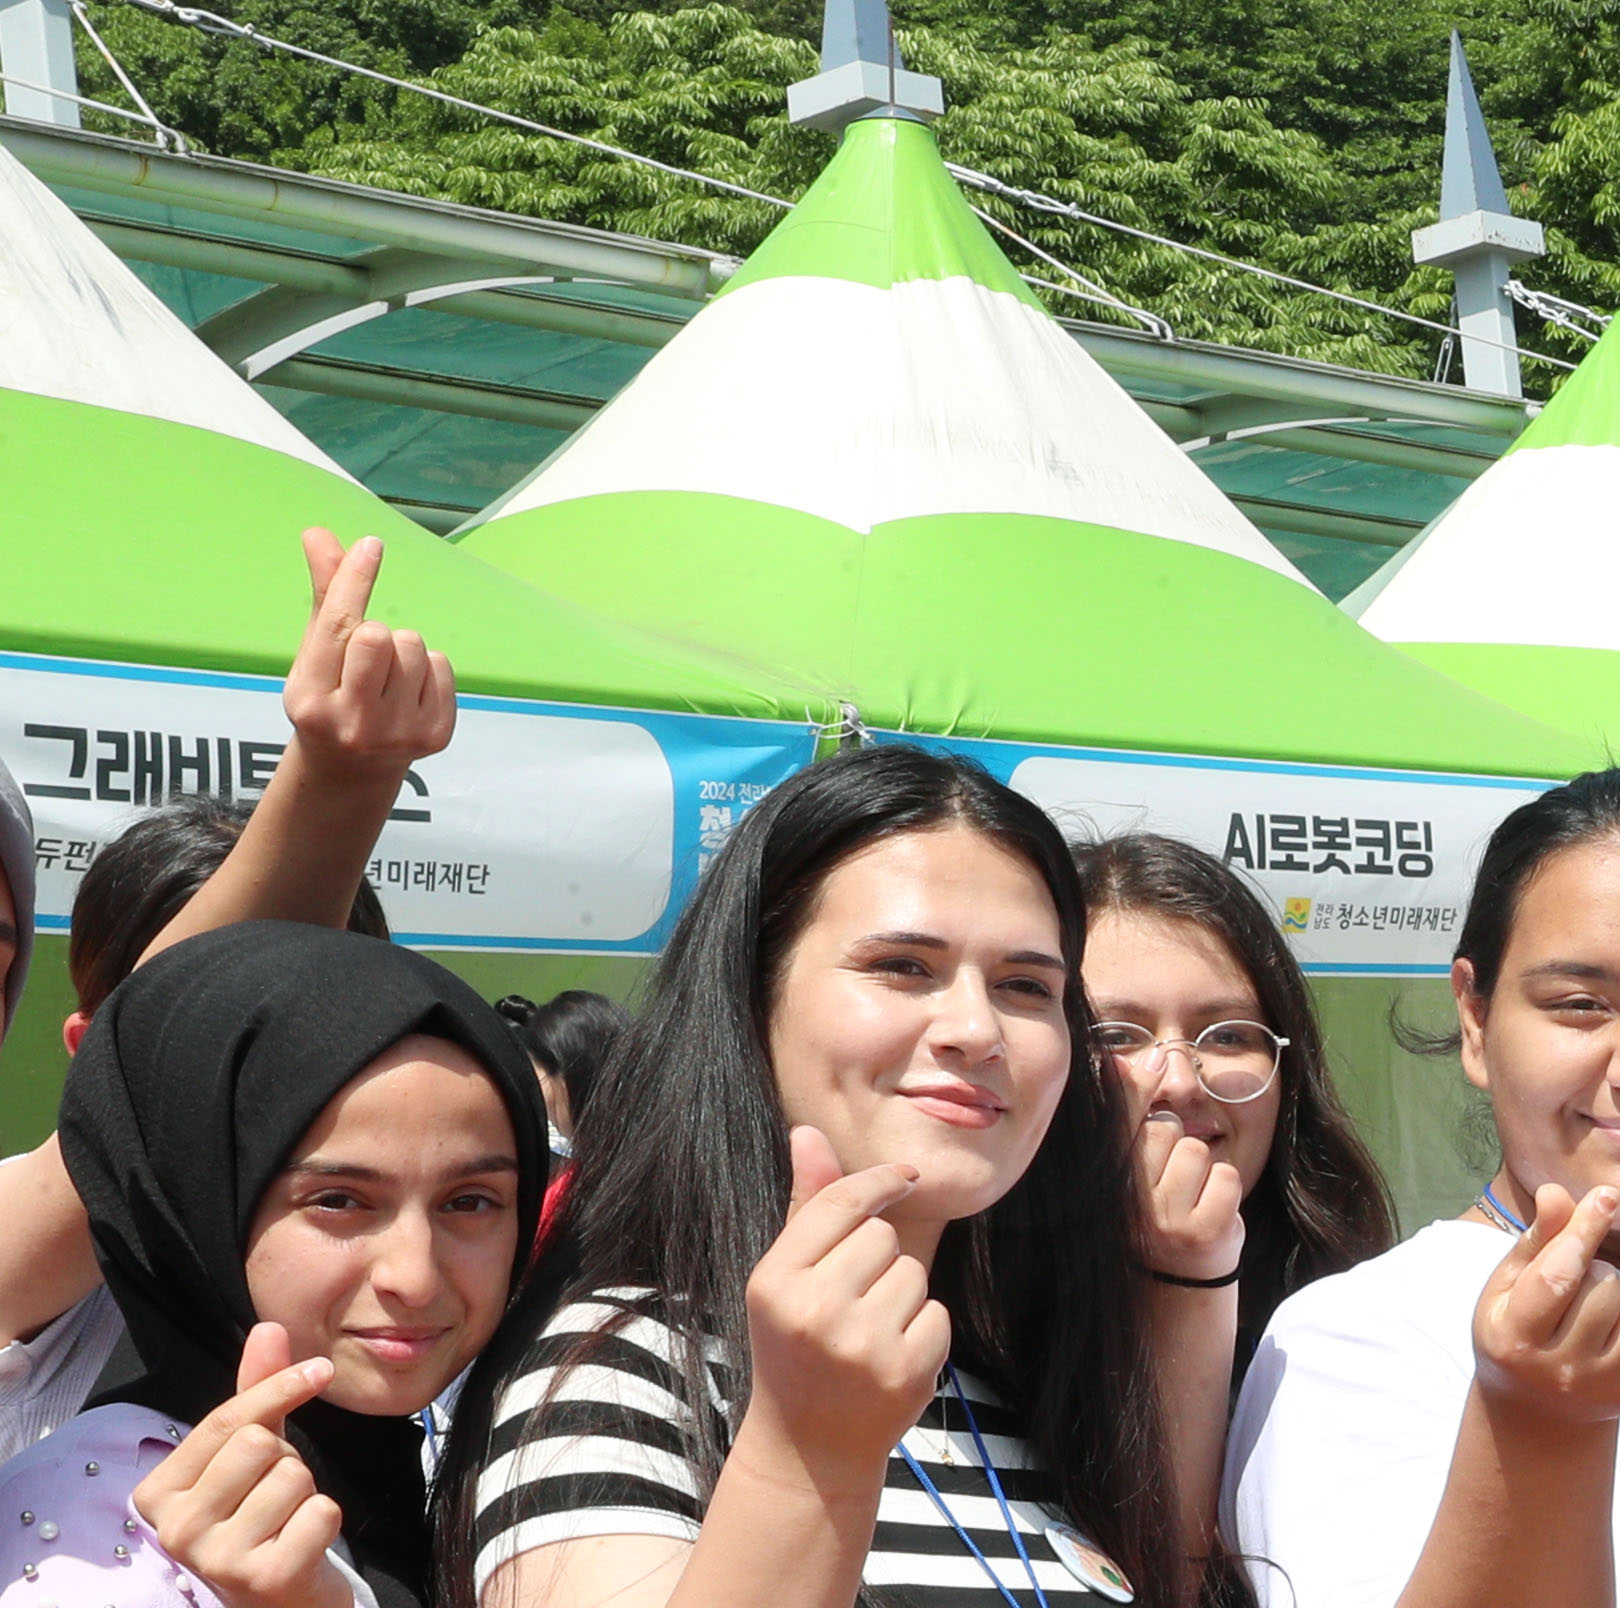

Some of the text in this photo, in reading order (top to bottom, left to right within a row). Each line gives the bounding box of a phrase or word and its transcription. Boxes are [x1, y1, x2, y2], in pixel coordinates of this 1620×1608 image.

[699, 780, 735, 801] 2024
[1223, 812, 1434, 878] AI로봇코딩
[1336, 903, 1457, 932] 청소년미래재단
